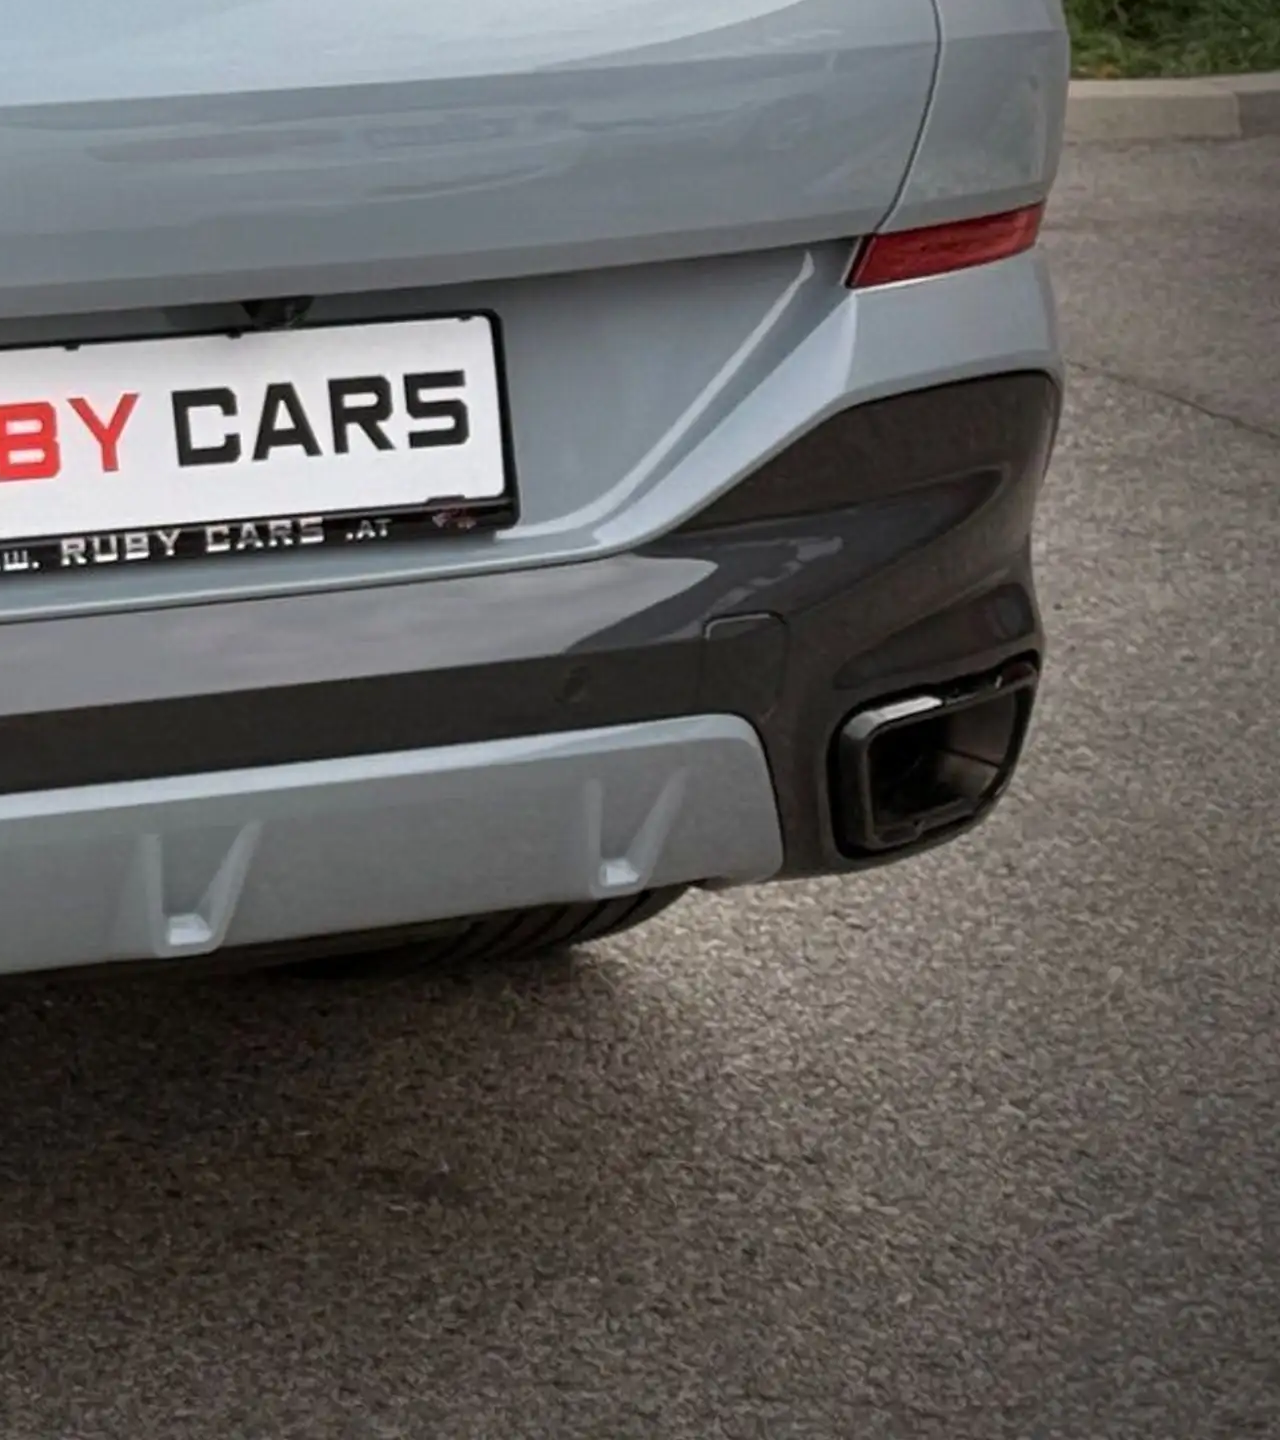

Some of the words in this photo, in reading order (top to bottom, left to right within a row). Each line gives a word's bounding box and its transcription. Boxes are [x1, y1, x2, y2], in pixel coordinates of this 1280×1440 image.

[171, 369, 470, 468] CARS
[60, 527, 182, 566] RUBY
[204, 515, 325, 553] CARS
